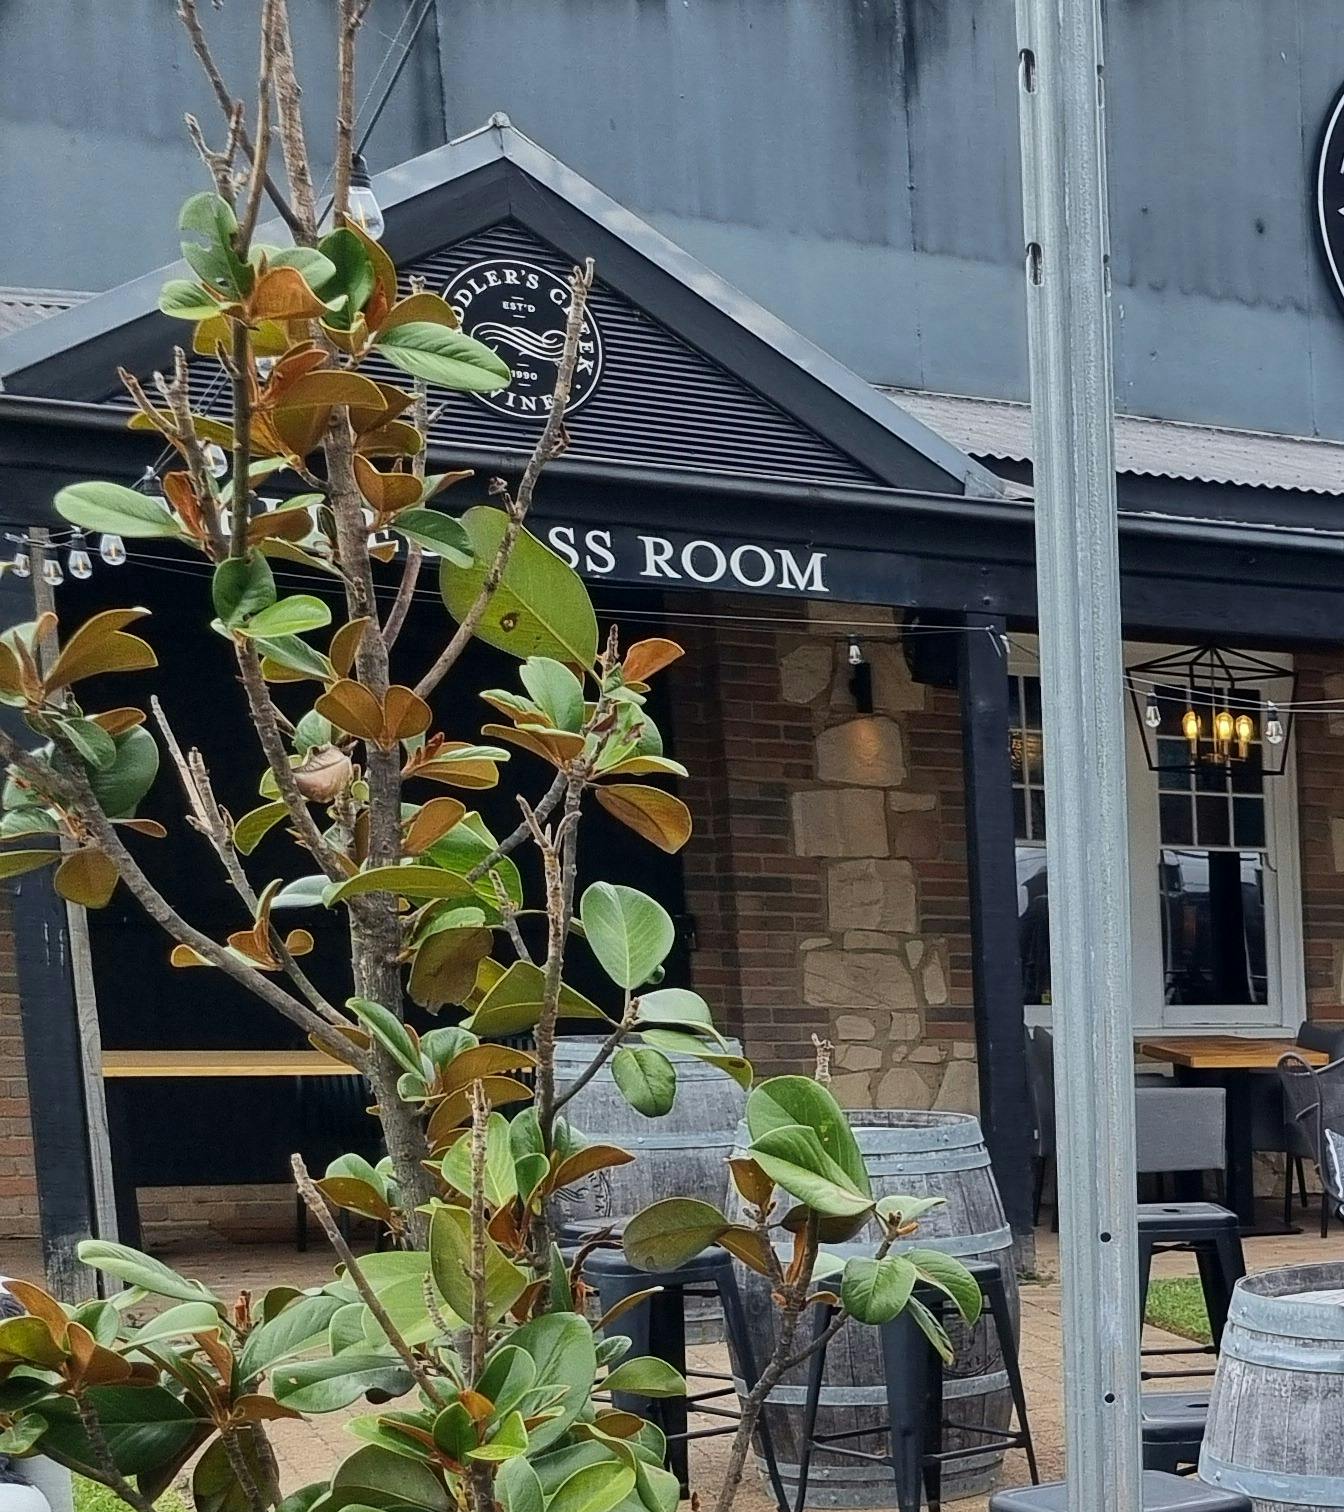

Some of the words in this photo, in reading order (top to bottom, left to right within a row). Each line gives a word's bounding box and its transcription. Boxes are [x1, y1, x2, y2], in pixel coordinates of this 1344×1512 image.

[453, 269, 539, 335] DDLER'S
[511, 369, 538, 381] 1990
[637, 535, 830, 593] ROOM
